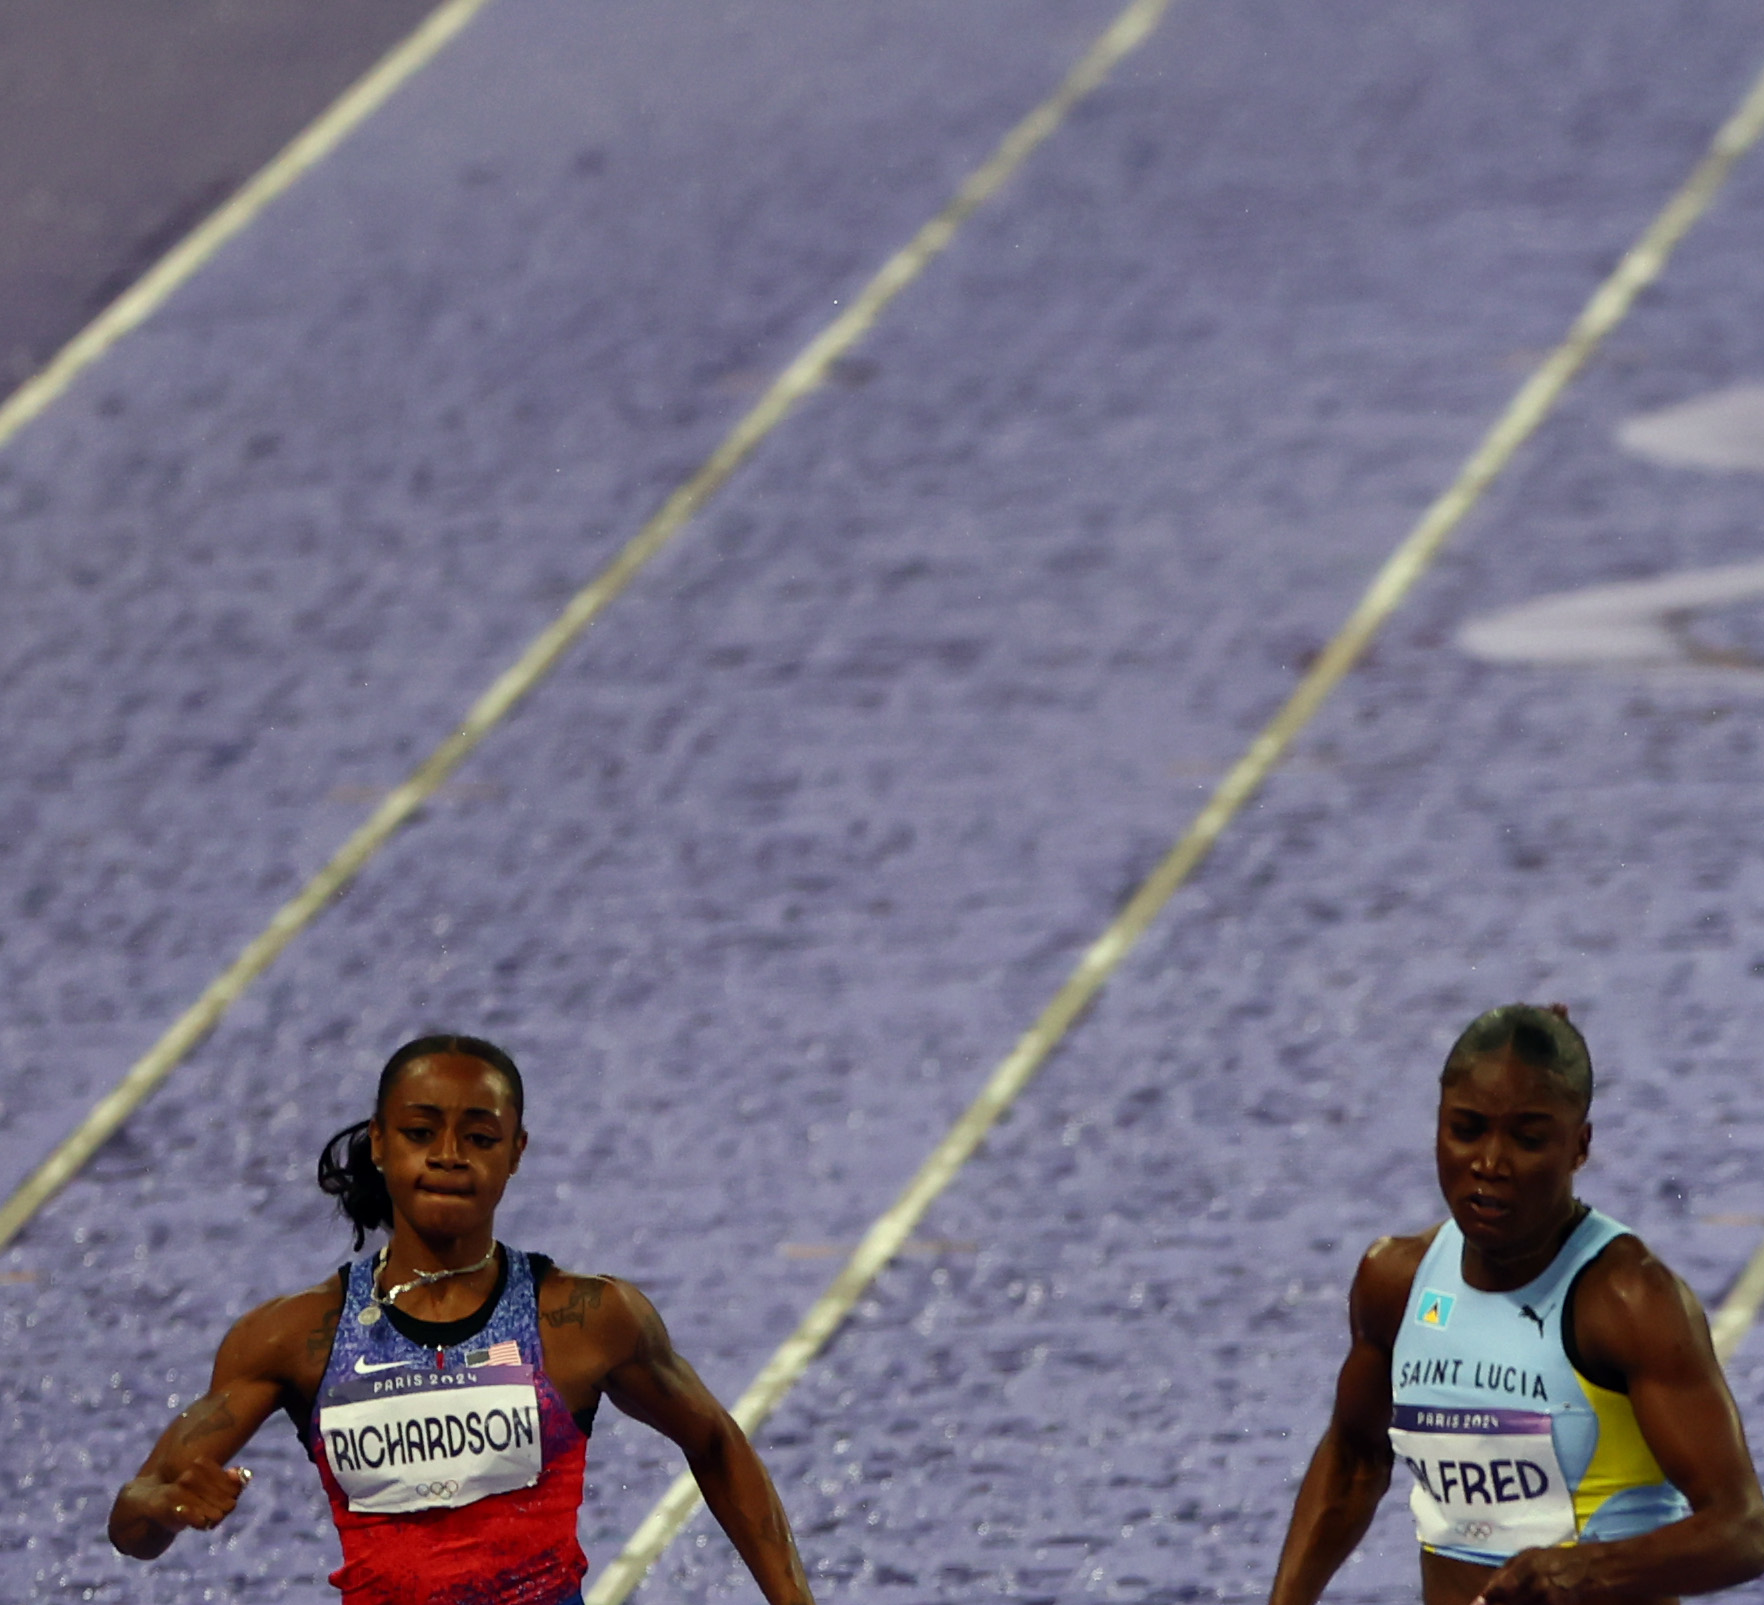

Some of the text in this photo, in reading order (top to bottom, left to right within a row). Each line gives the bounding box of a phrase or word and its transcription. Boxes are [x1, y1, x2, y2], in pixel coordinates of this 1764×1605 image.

[374, 1372, 477, 1393] PARIS 2024
[1400, 1359, 1548, 1401] SAINT LUCIA
[1417, 1411, 1499, 1429] PARIS 2024
[331, 1406, 533, 1472] RICHARDSON
